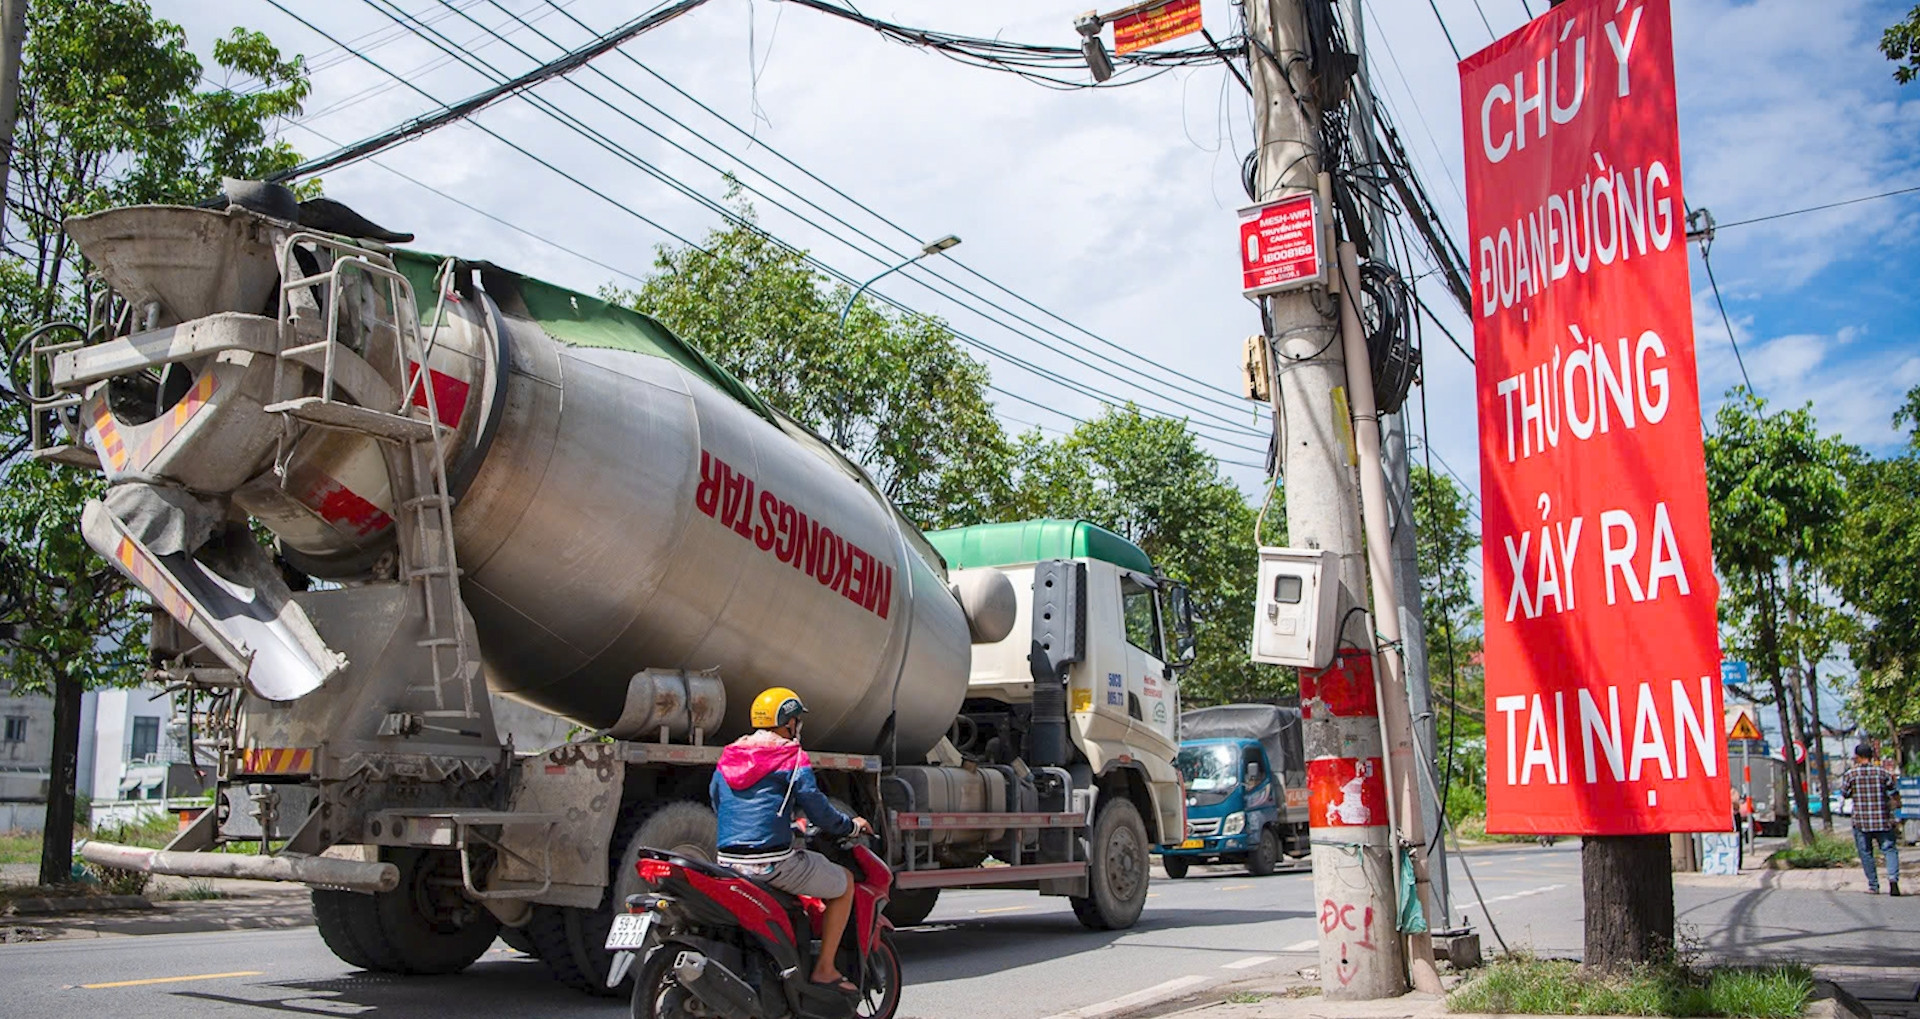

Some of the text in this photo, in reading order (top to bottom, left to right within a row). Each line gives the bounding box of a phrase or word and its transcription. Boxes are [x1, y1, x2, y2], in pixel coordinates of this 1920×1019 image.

[1481, 0, 1643, 163] CHÚ Ý
[1259, 209, 1310, 228] MESH-WIFI
[1269, 231, 1303, 243] CAMERA
[1479, 152, 1673, 322] ĐOẠN ĐƯỜNG
[1497, 324, 1670, 463] THƯỜNG
[696, 449, 892, 620] MEKONGSTAR
[1503, 492, 1690, 622] XẢY RA
[1496, 676, 1718, 806] TAI NẠN
